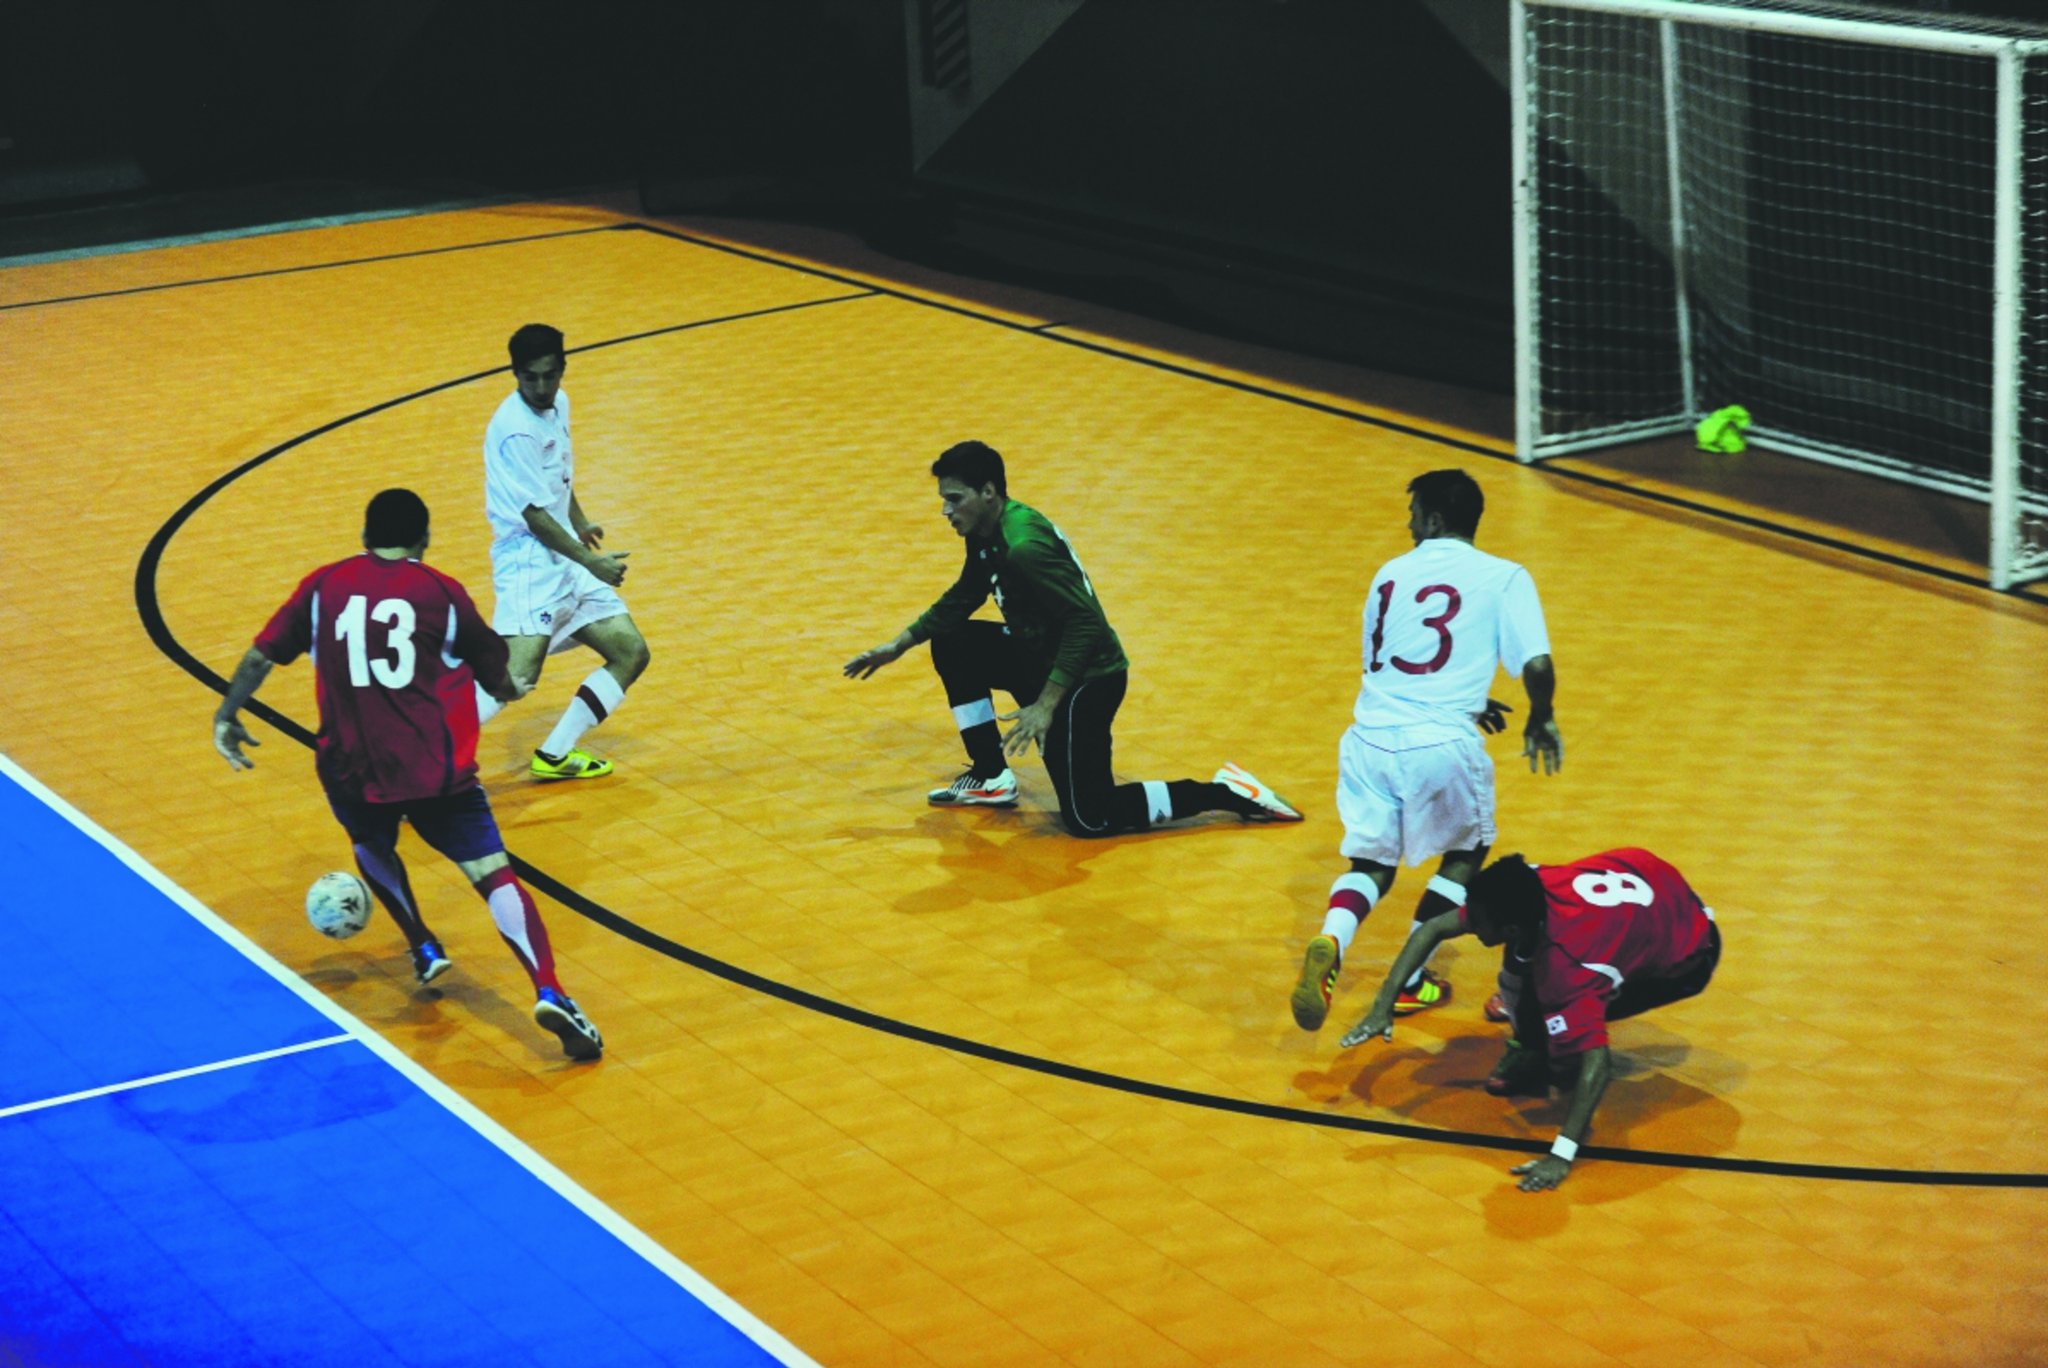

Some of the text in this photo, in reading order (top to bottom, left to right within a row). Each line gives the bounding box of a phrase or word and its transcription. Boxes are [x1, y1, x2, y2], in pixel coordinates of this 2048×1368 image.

[334, 595, 416, 689] 13
[1361, 579, 1462, 675] 13
[1572, 870, 1654, 907] 8
